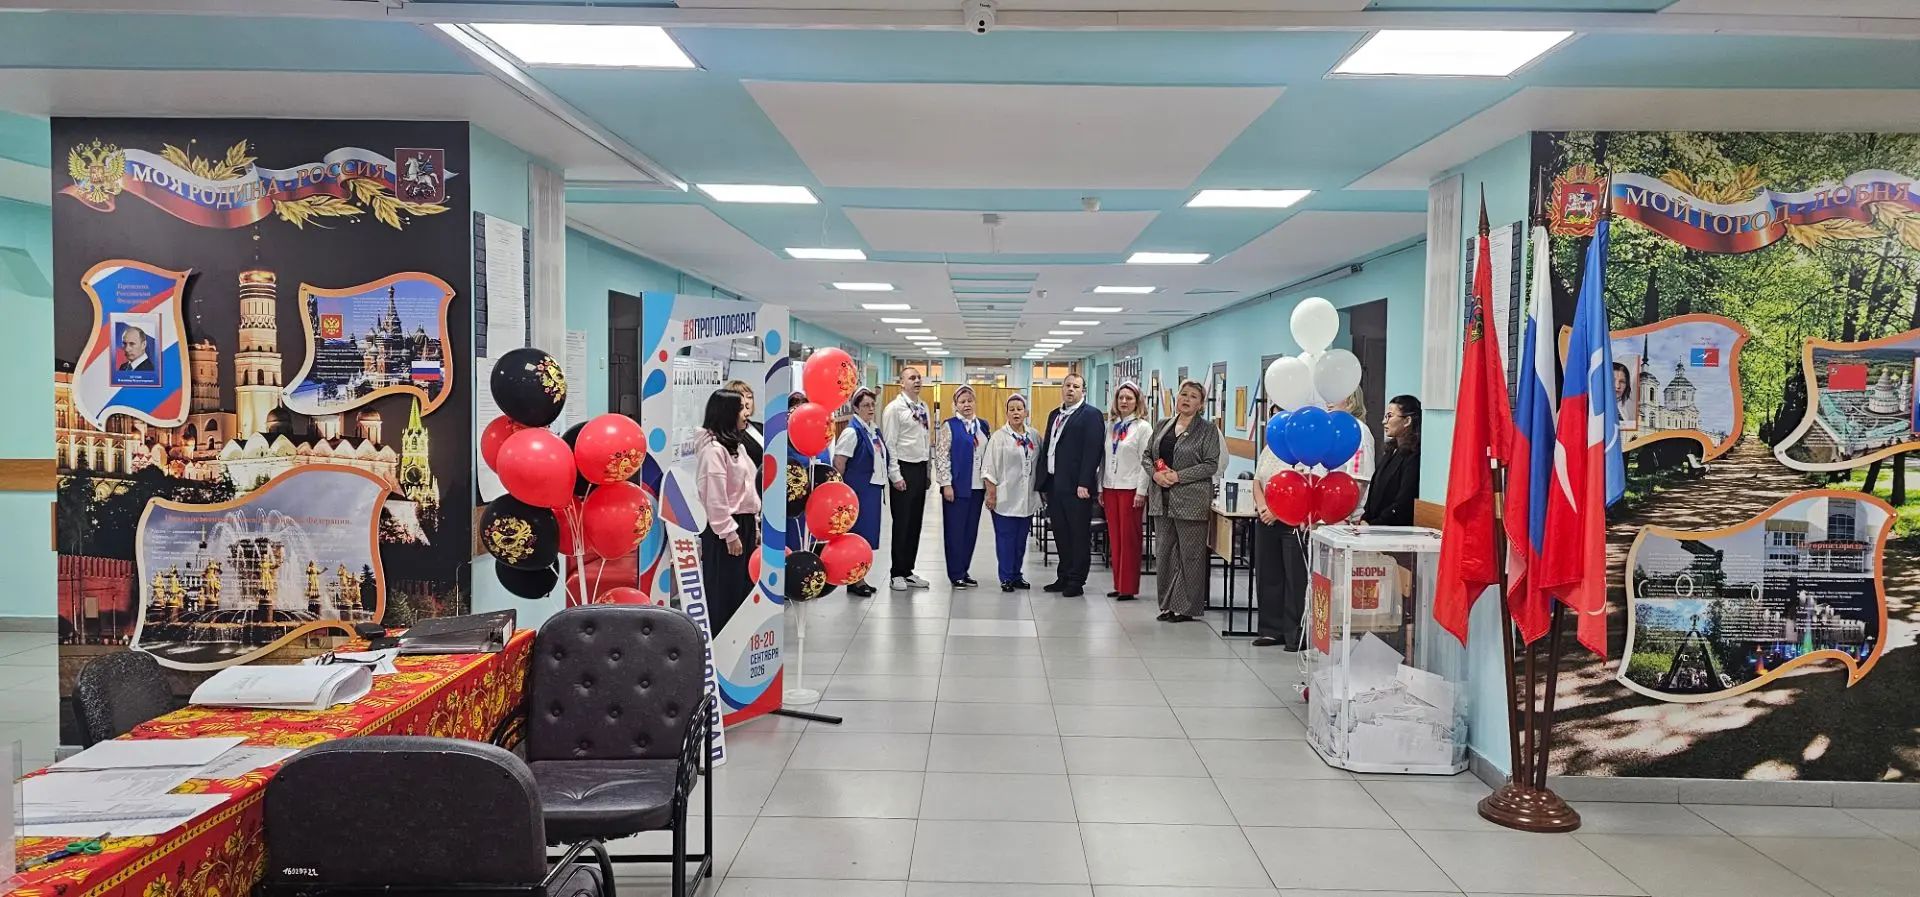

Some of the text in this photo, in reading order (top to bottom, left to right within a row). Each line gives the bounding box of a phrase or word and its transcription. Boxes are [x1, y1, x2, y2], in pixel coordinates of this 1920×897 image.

[132, 163, 184, 195] МОЯ
[187, 176, 281, 210] РОДИНА
[296, 159, 388, 188] РОССИЯ
[1624, 186, 1692, 224] МОЙ
[1699, 203, 1791, 235] ГОРОД
[1811, 181, 1911, 211] ЛОБНЯ
[683, 311, 756, 341] #ЯПРОГОЛОСОВАЛ
[1352, 566, 1386, 577] ЫБОРЫ
[750, 630, 775, 652] 18-20
[750, 647, 779, 665] СЕНТЯБРЯ
